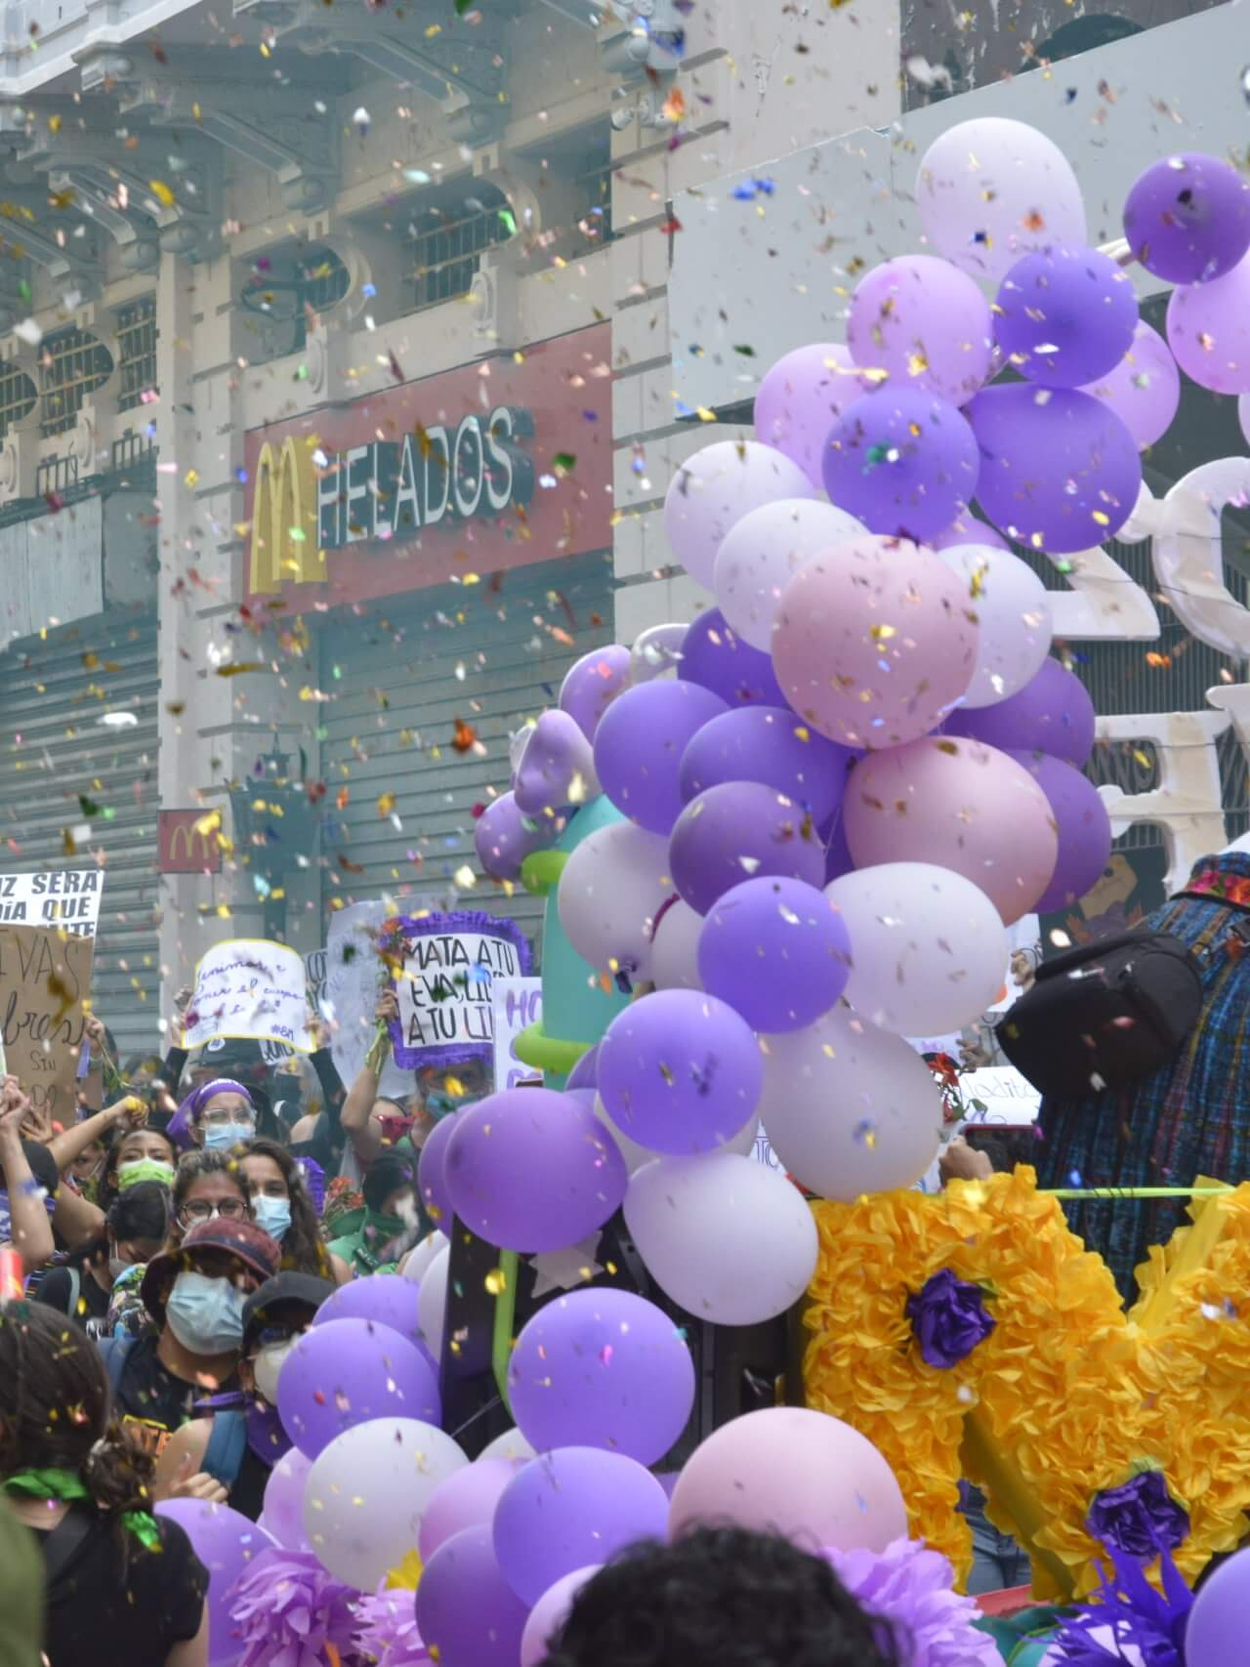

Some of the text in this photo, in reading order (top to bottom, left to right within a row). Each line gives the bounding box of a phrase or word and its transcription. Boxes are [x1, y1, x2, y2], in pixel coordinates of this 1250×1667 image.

[316, 407, 514, 548] HELADOS
[31, 872, 98, 895] SERA
[42, 896, 91, 922] QUE
[403, 936, 470, 970] MATA
[492, 941, 515, 976] TU
[408, 1012, 426, 1046] A
[427, 1006, 456, 1040] TU
